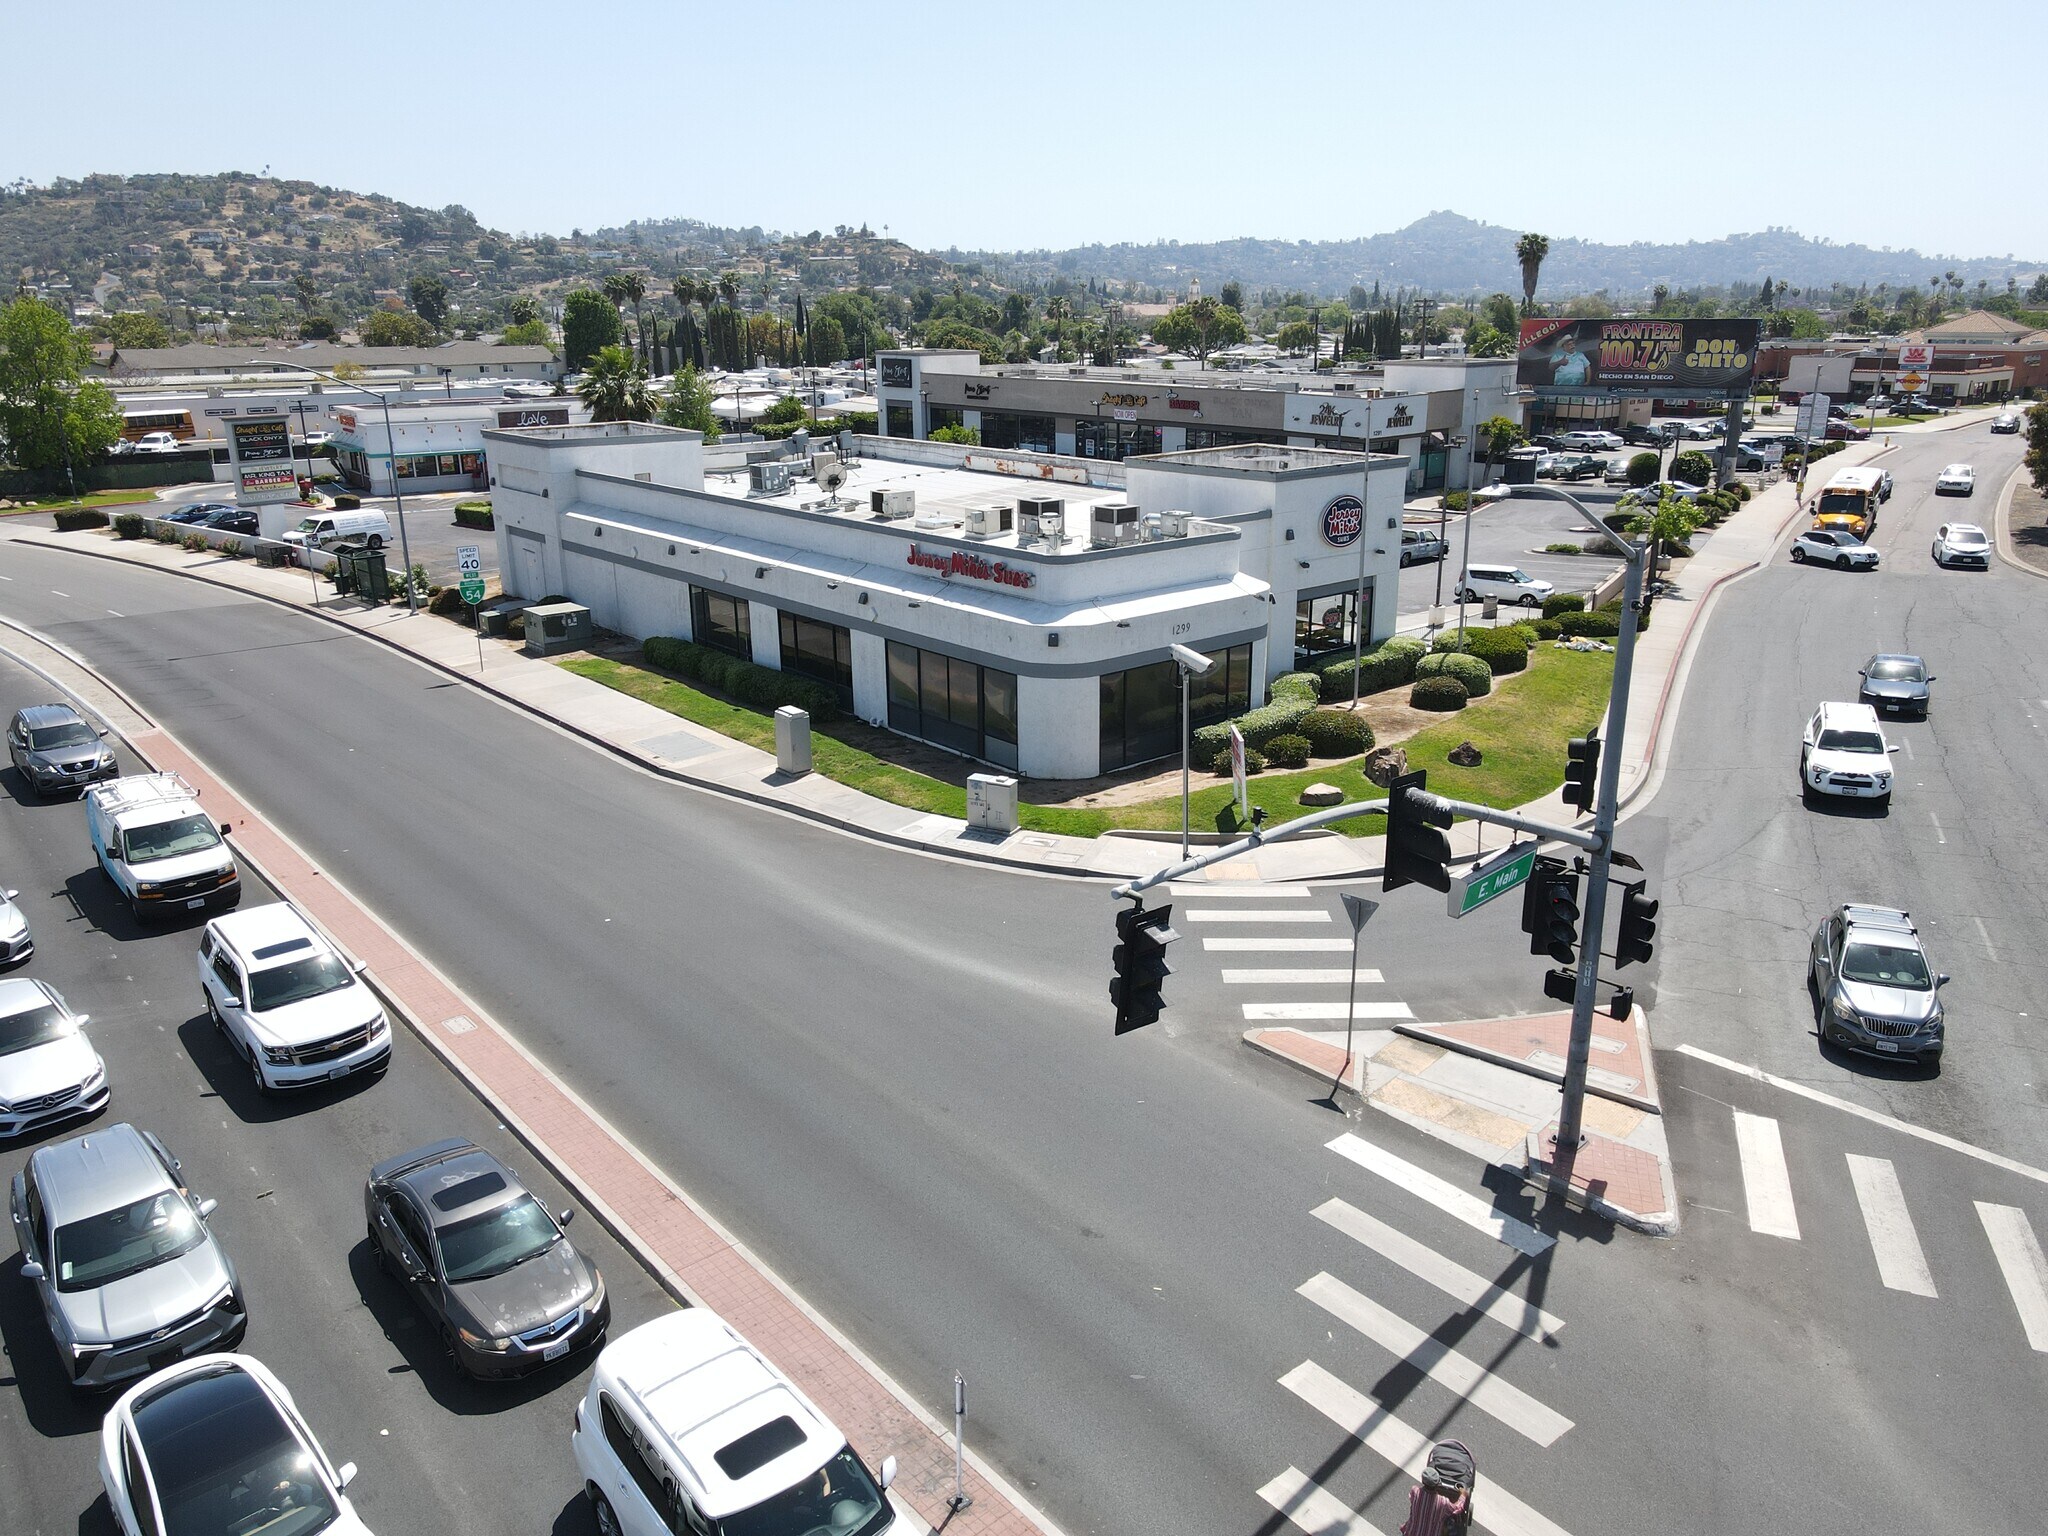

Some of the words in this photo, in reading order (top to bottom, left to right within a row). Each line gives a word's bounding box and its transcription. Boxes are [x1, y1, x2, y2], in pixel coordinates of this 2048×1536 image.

[1602, 322, 1682, 340] FRONTERA
[1599, 339, 1654, 368] 100.7
[1660, 340, 1681, 352] FM
[1695, 339, 1736, 354] DON
[1685, 353, 1748, 369] CHETO
[1650, 373, 1674, 381] DIEGO
[1169, 400, 1200, 411] BARBER
[1114, 410, 1124, 418] NOW
[1125, 410, 1137, 419] OPEN
[1310, 414, 1345, 427] JEWELRY
[1386, 415, 1414, 429] JEWELRY
[1328, 506, 1361, 523] Jersey
[461, 559, 479, 569] 40
[907, 543, 948, 578] Jersey
[993, 562, 1030, 588] Subs
[466, 590, 481, 600] 54
[1172, 622, 1191, 635] 1299
[1478, 882, 1489, 899] E.
[1493, 868, 1519, 890] Main
